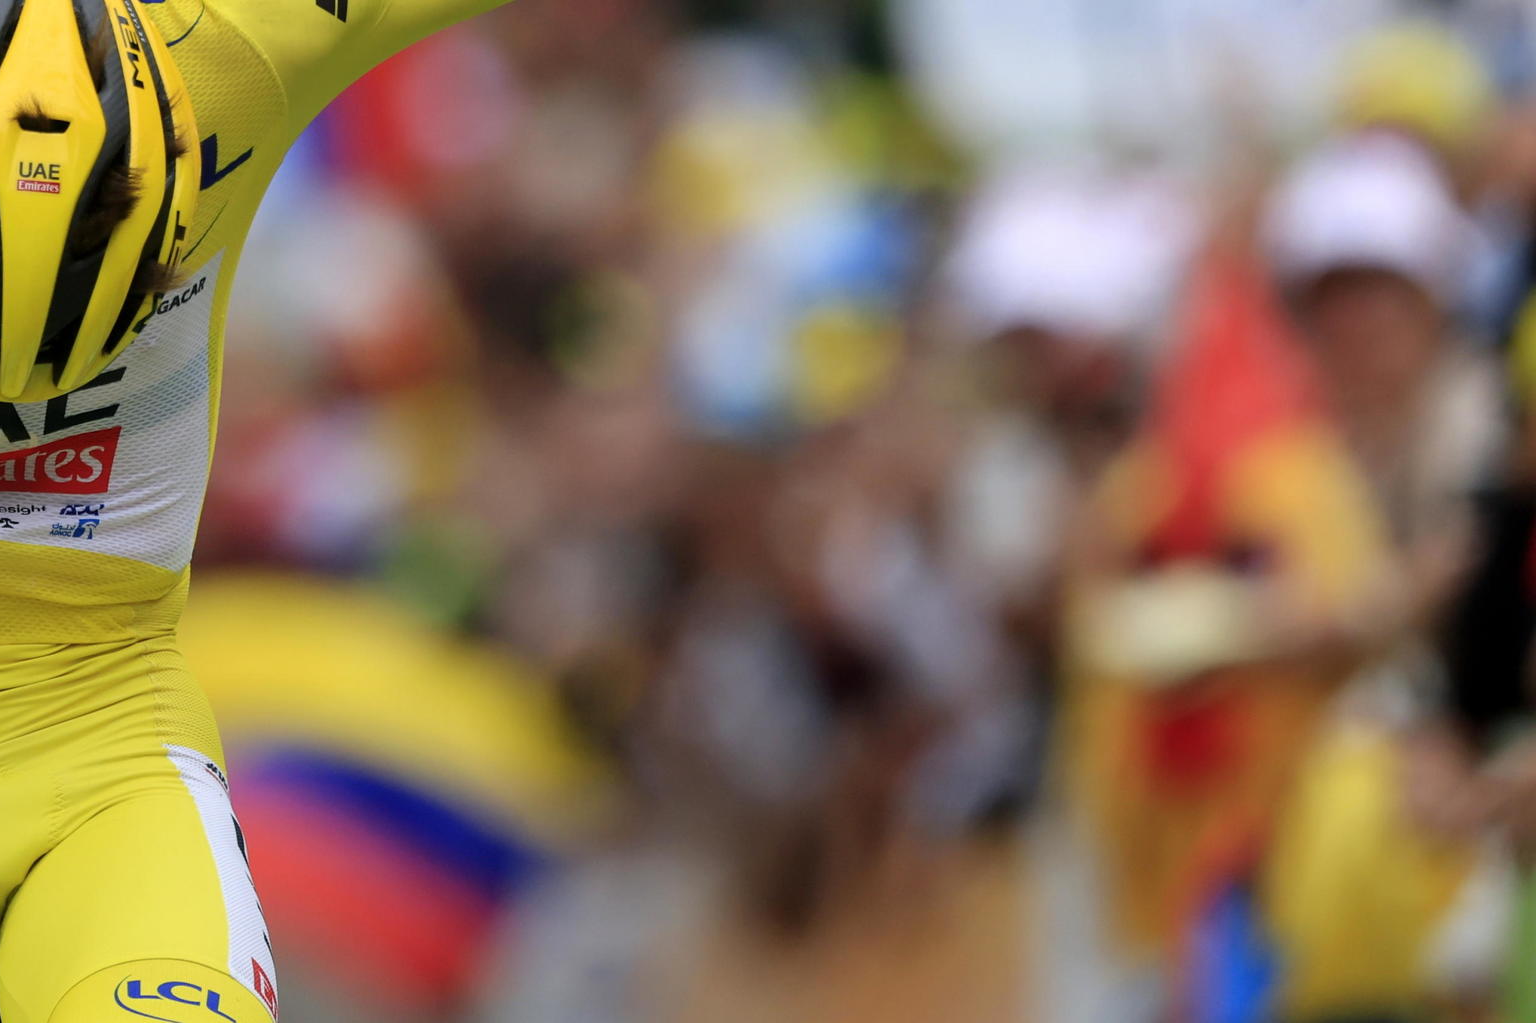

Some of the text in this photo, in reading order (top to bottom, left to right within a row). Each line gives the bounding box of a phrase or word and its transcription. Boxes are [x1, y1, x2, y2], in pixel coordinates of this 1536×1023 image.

[113, 8, 145, 89] MET
[19, 161, 61, 180] UAE
[18, 181, 60, 193] Emirates
[127, 979, 237, 1023] LCL
